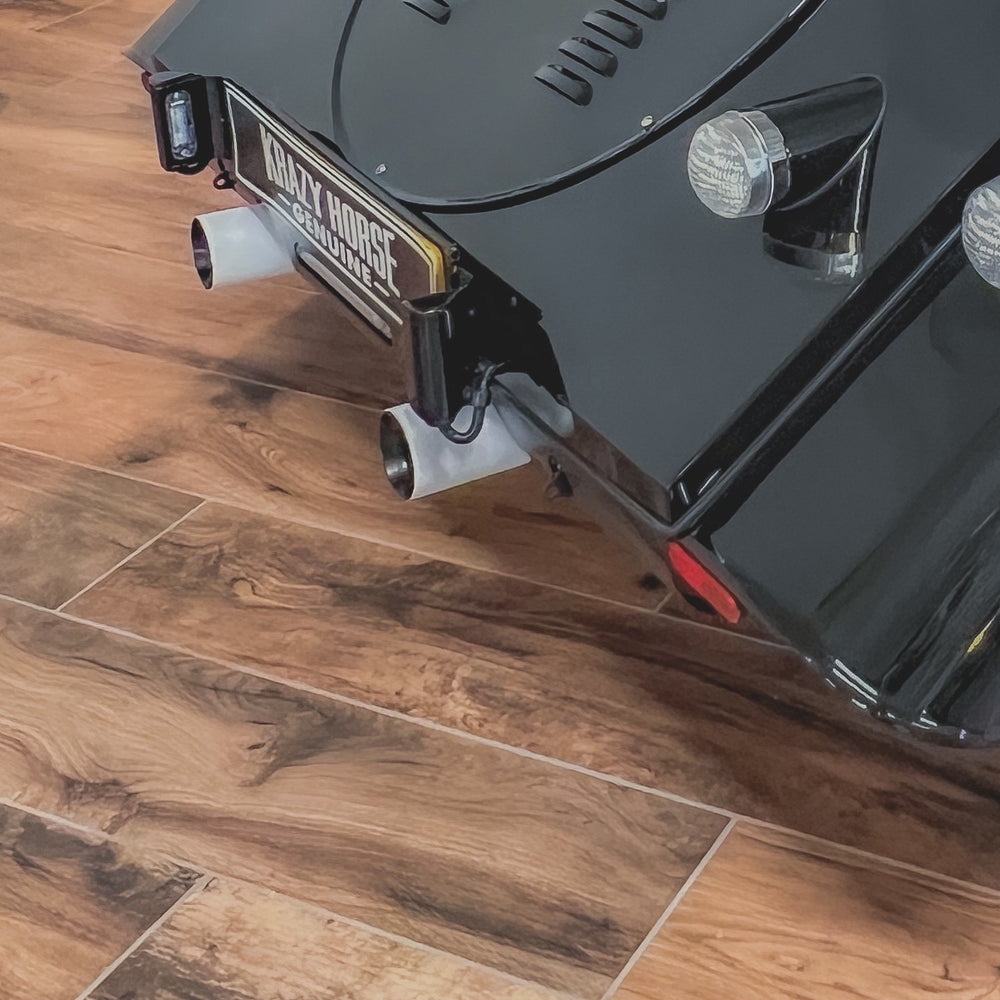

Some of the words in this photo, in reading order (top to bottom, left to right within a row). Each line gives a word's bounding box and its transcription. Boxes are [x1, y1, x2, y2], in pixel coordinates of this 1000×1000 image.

[259, 123, 322, 219] KRAZY
[326, 190, 400, 298] HORSE
[292, 202, 373, 287] GENUINE
